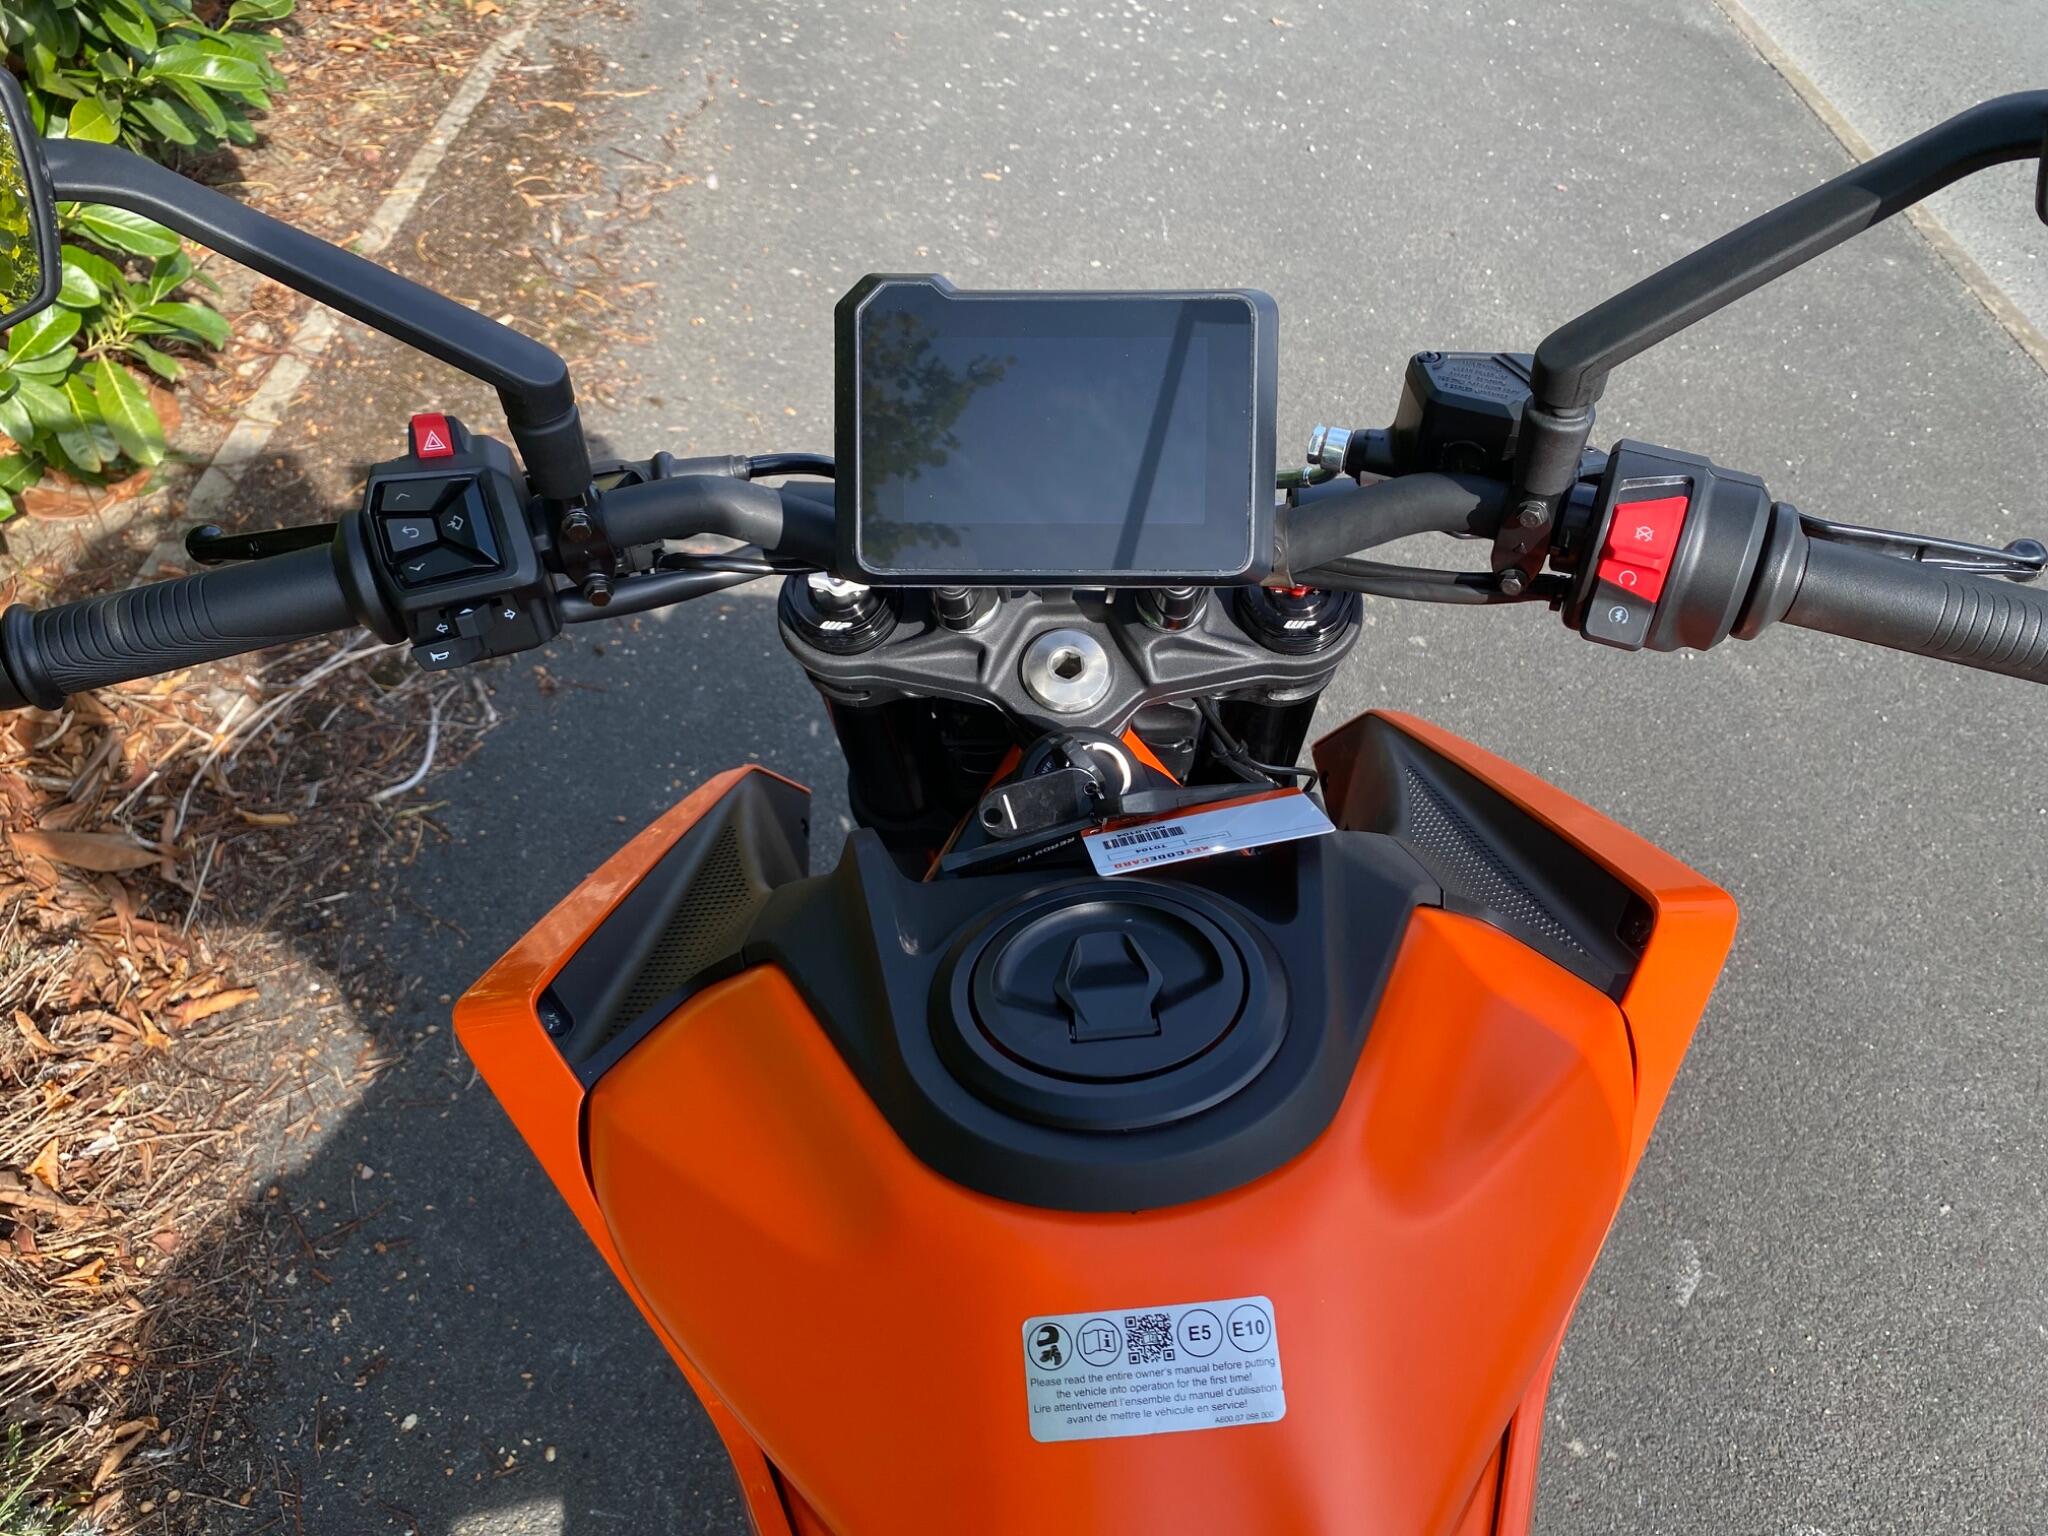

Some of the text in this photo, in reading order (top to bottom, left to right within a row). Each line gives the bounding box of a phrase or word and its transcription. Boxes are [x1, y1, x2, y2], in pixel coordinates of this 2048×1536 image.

[1283, 620, 1318, 629] WP
[1188, 1325, 1212, 1341] E5
[1232, 1319, 1265, 1337] E10
[1030, 1358, 1276, 1387] Please read the entire owner's manual before putting
[1056, 1372, 1253, 1399] the vehicle into operation for the first time!
[1033, 1383, 1278, 1414] Lire attentivement l'ensemble du manuel d'utilisation
[1066, 1399, 1248, 1425] avant de mettre le véhicule en service!
